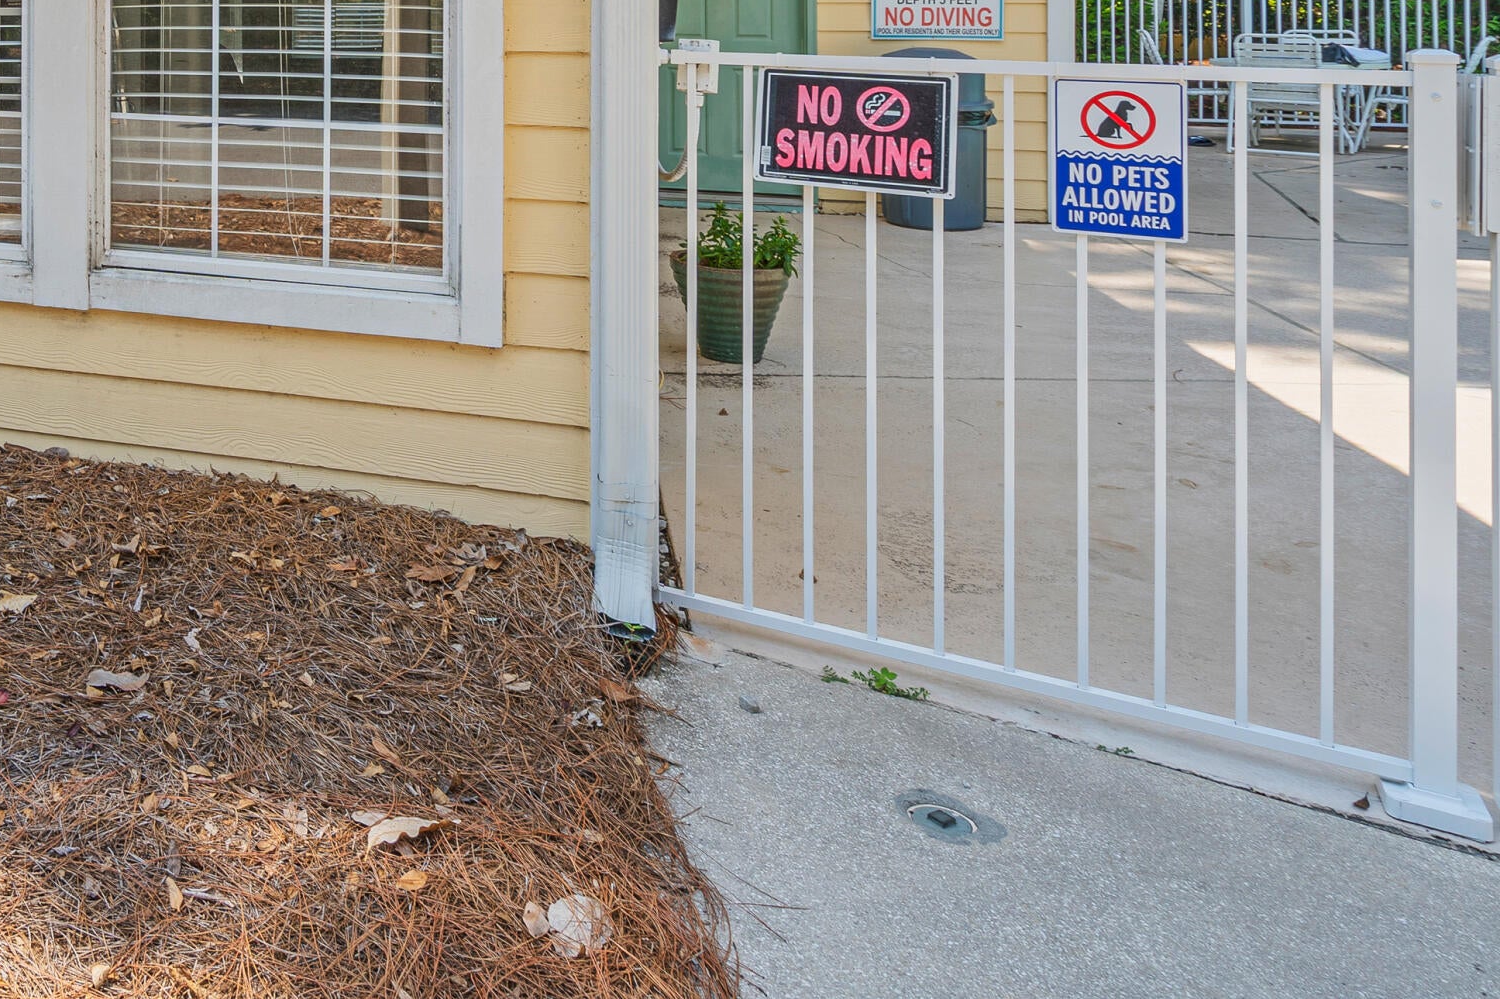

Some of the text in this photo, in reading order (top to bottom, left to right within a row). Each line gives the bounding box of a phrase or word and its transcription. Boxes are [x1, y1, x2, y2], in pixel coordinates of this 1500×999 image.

[885, 7, 992, 27] NO DIVING
[797, 85, 842, 126] NO
[775, 128, 932, 180] SMOKING
[1069, 162, 1170, 189] NO PETS
[1062, 186, 1176, 214] ALLOWED
[1069, 210, 1170, 230] IN POOL AREA
